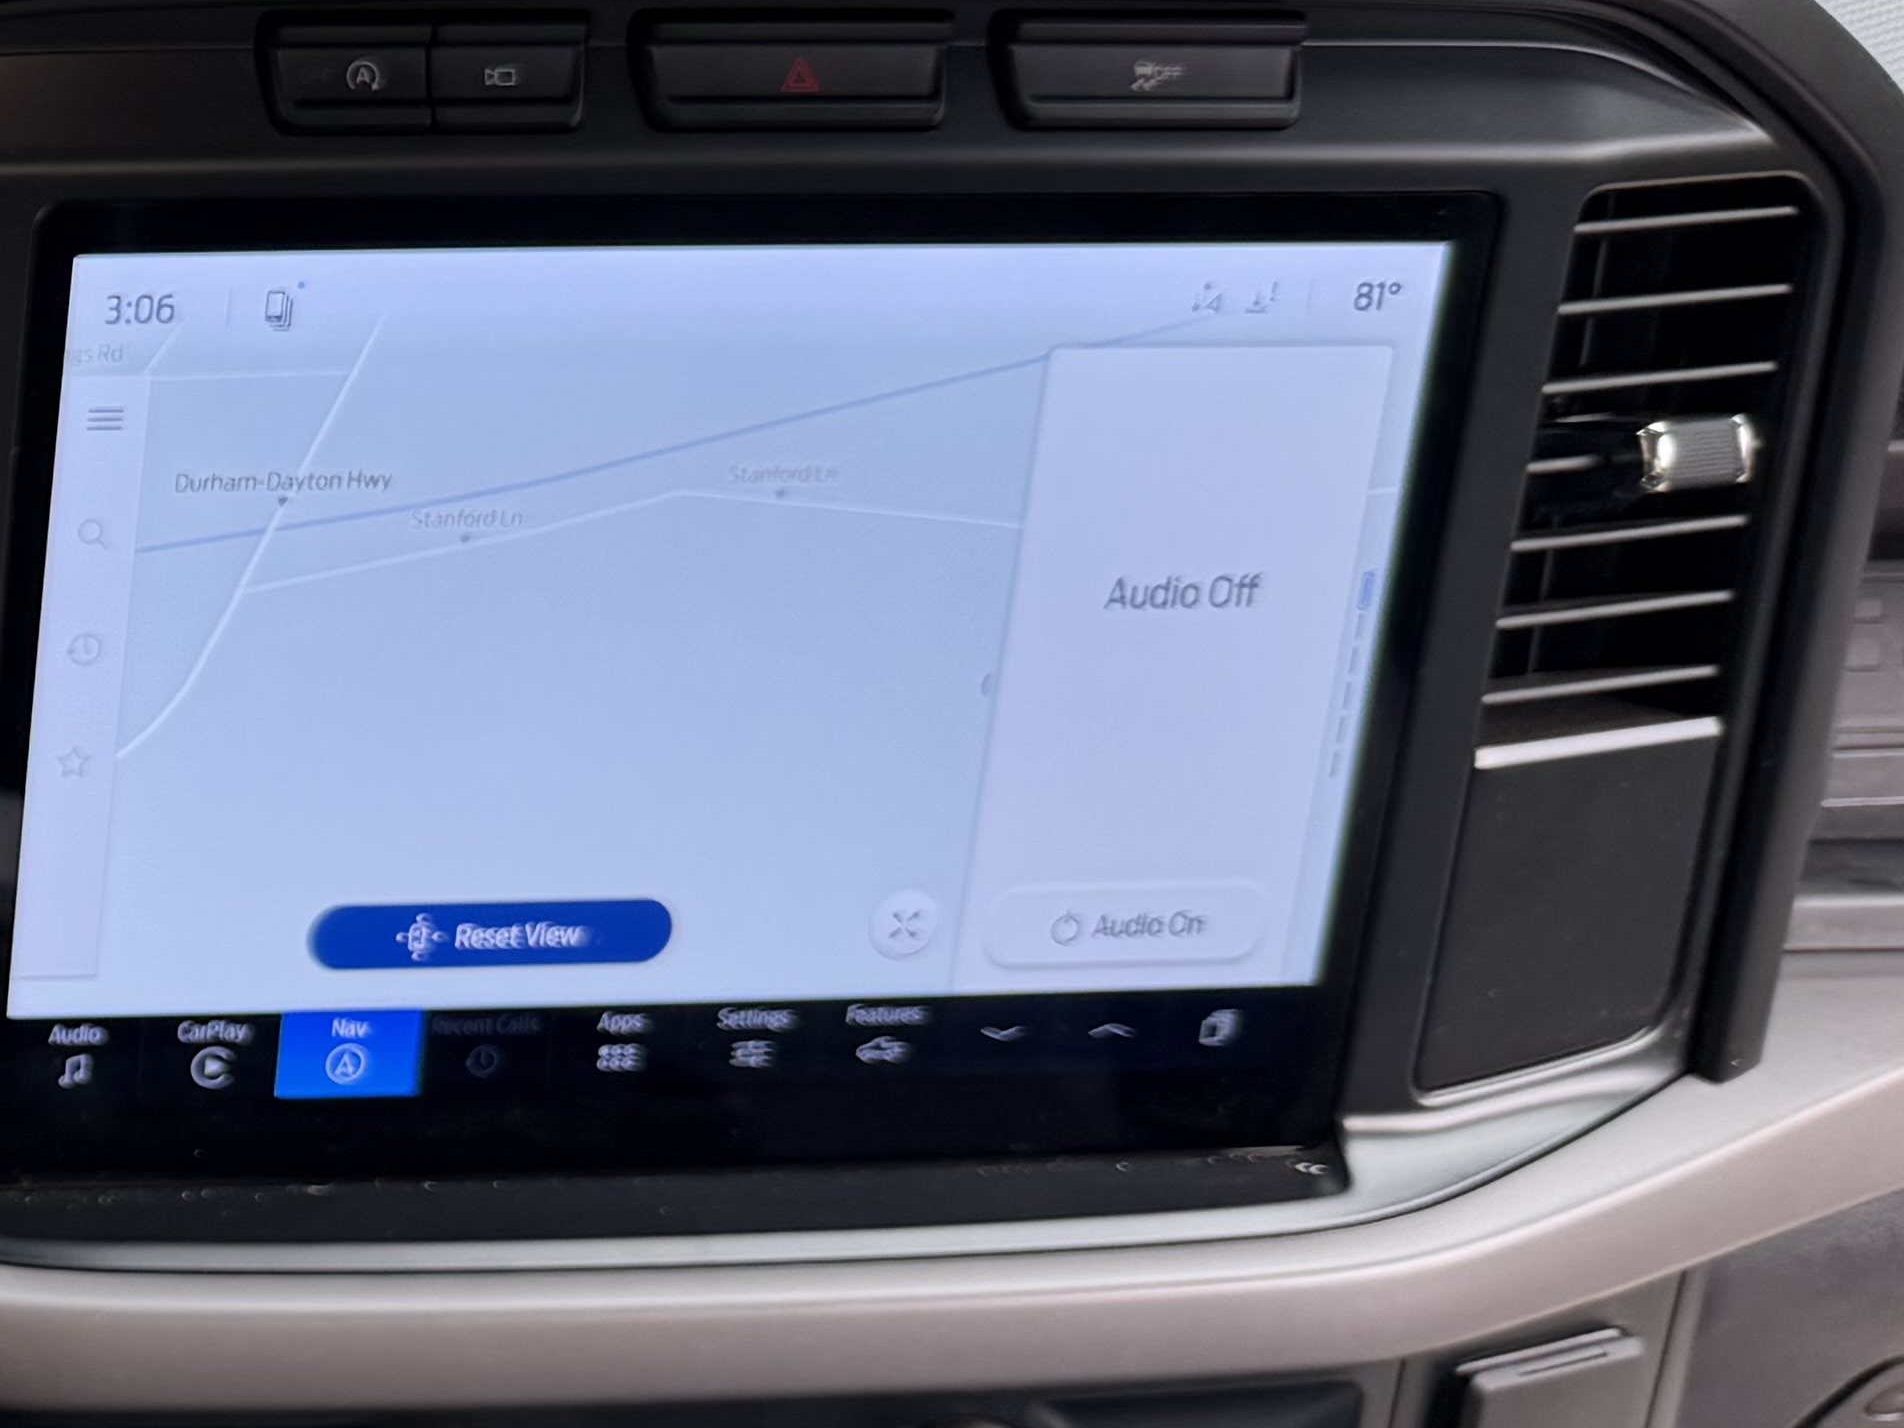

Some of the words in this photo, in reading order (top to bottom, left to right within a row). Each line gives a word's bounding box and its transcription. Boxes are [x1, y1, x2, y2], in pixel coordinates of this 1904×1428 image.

[104, 293, 176, 325] 3:06
[174, 471, 342, 494] Durham-Dayton
[346, 470, 393, 492] Hwy
[410, 508, 493, 529] Stanford
[499, 510, 524, 528] Ln
[1103, 574, 1199, 611] Audio
[1207, 572, 1263, 609] Off
[454, 922, 526, 949] Reset
[524, 921, 591, 948] View
[1090, 913, 1166, 938] Audio
[1167, 910, 1209, 936] On
[48, 1023, 107, 1046] Audio
[177, 1020, 255, 1045] CarPlay
[331, 1017, 370, 1039] Nav
[596, 1010, 654, 1036] Apps
